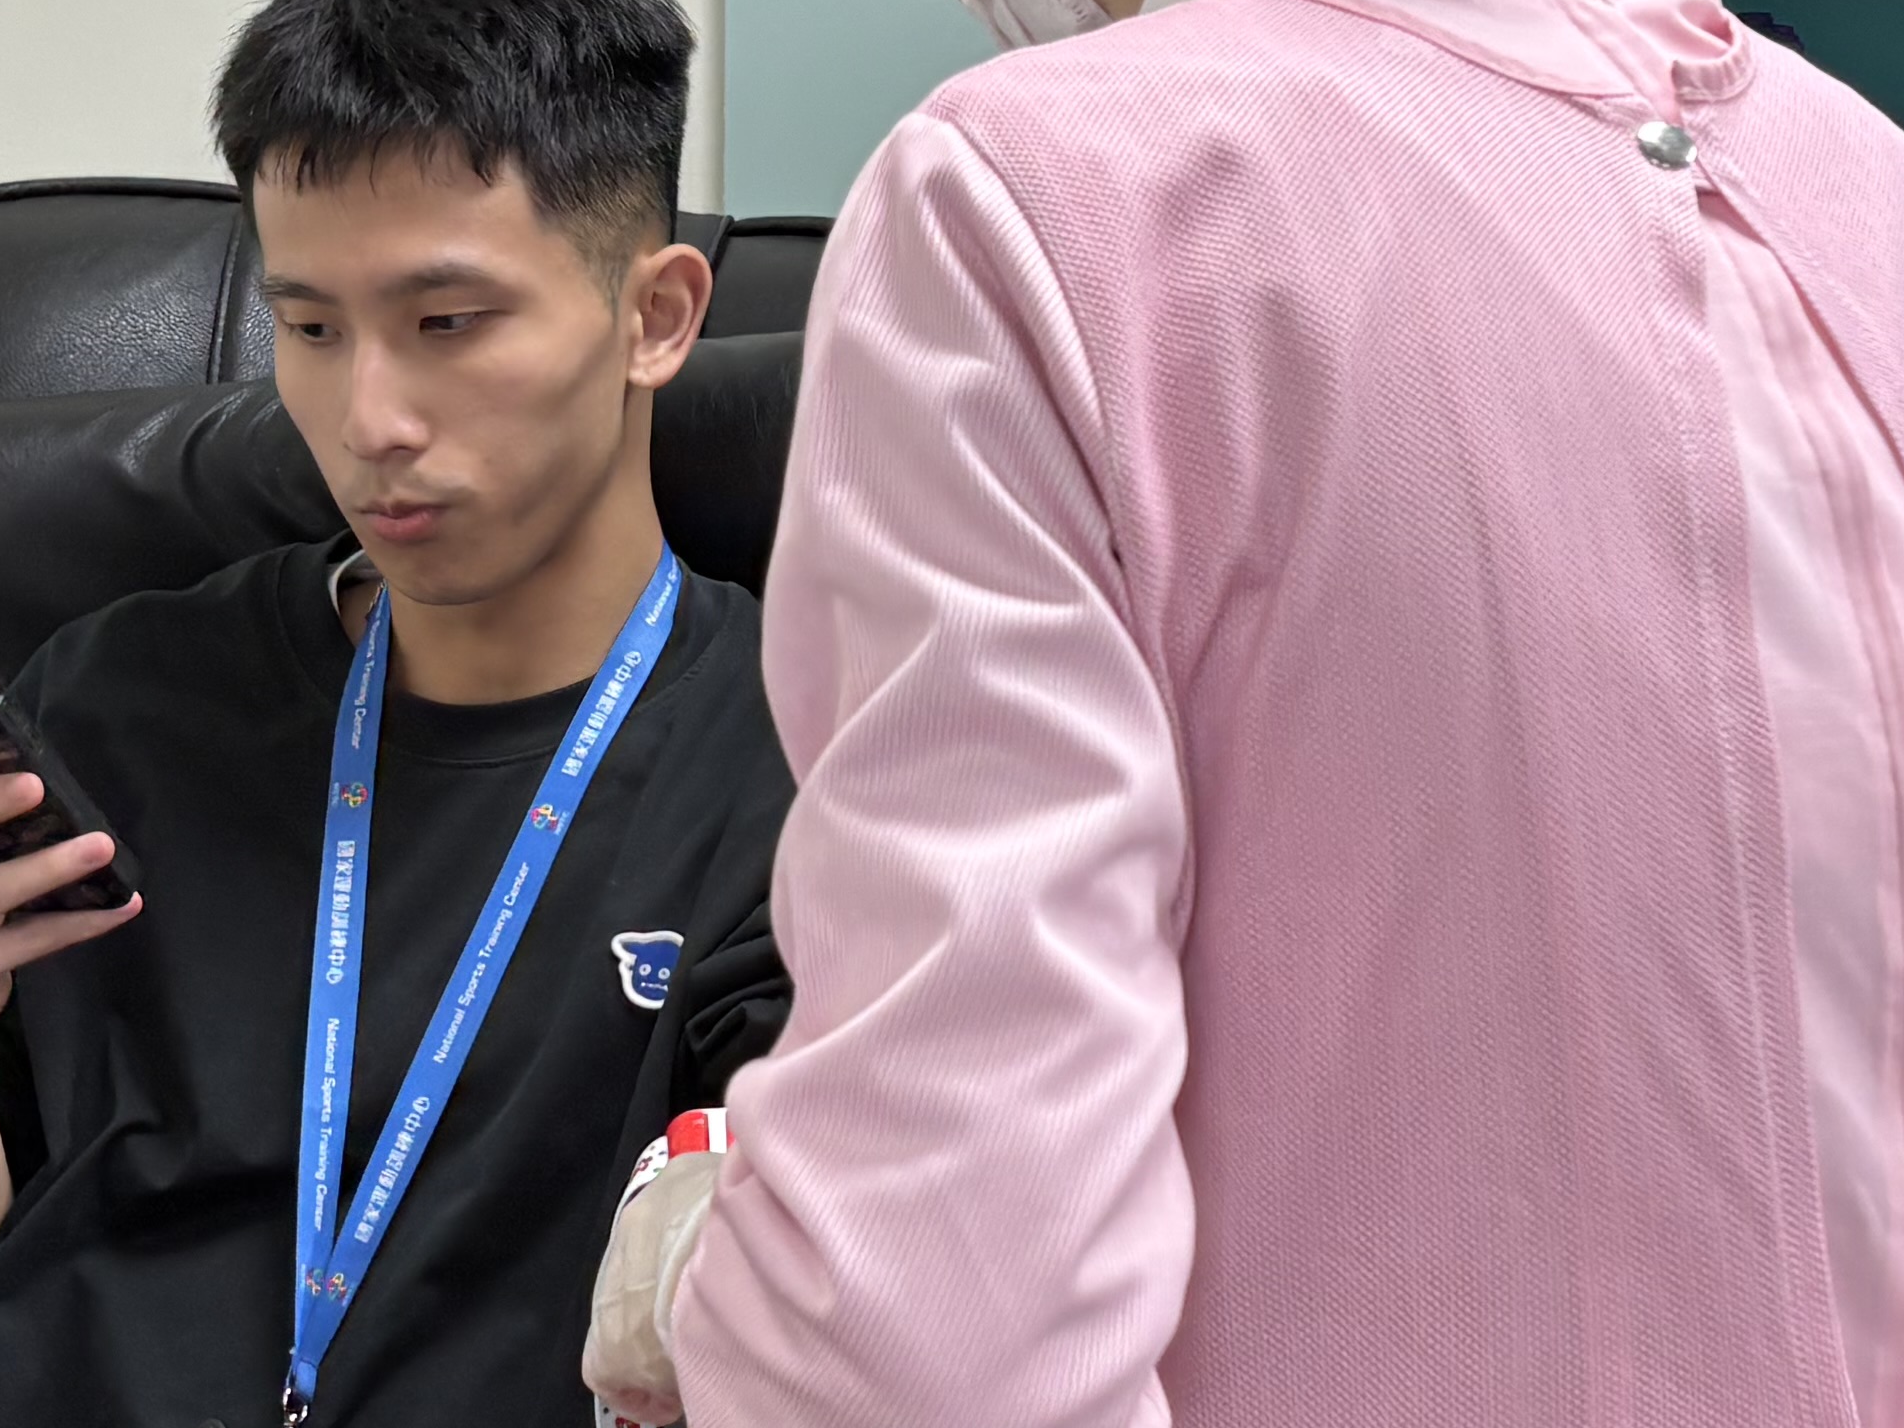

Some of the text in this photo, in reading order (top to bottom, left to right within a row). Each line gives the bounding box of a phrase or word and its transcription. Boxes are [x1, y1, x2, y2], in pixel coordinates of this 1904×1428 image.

[432, 862, 530, 1064] National Sports Training Center
[314, 1018, 341, 1232] National Sports Training Center
